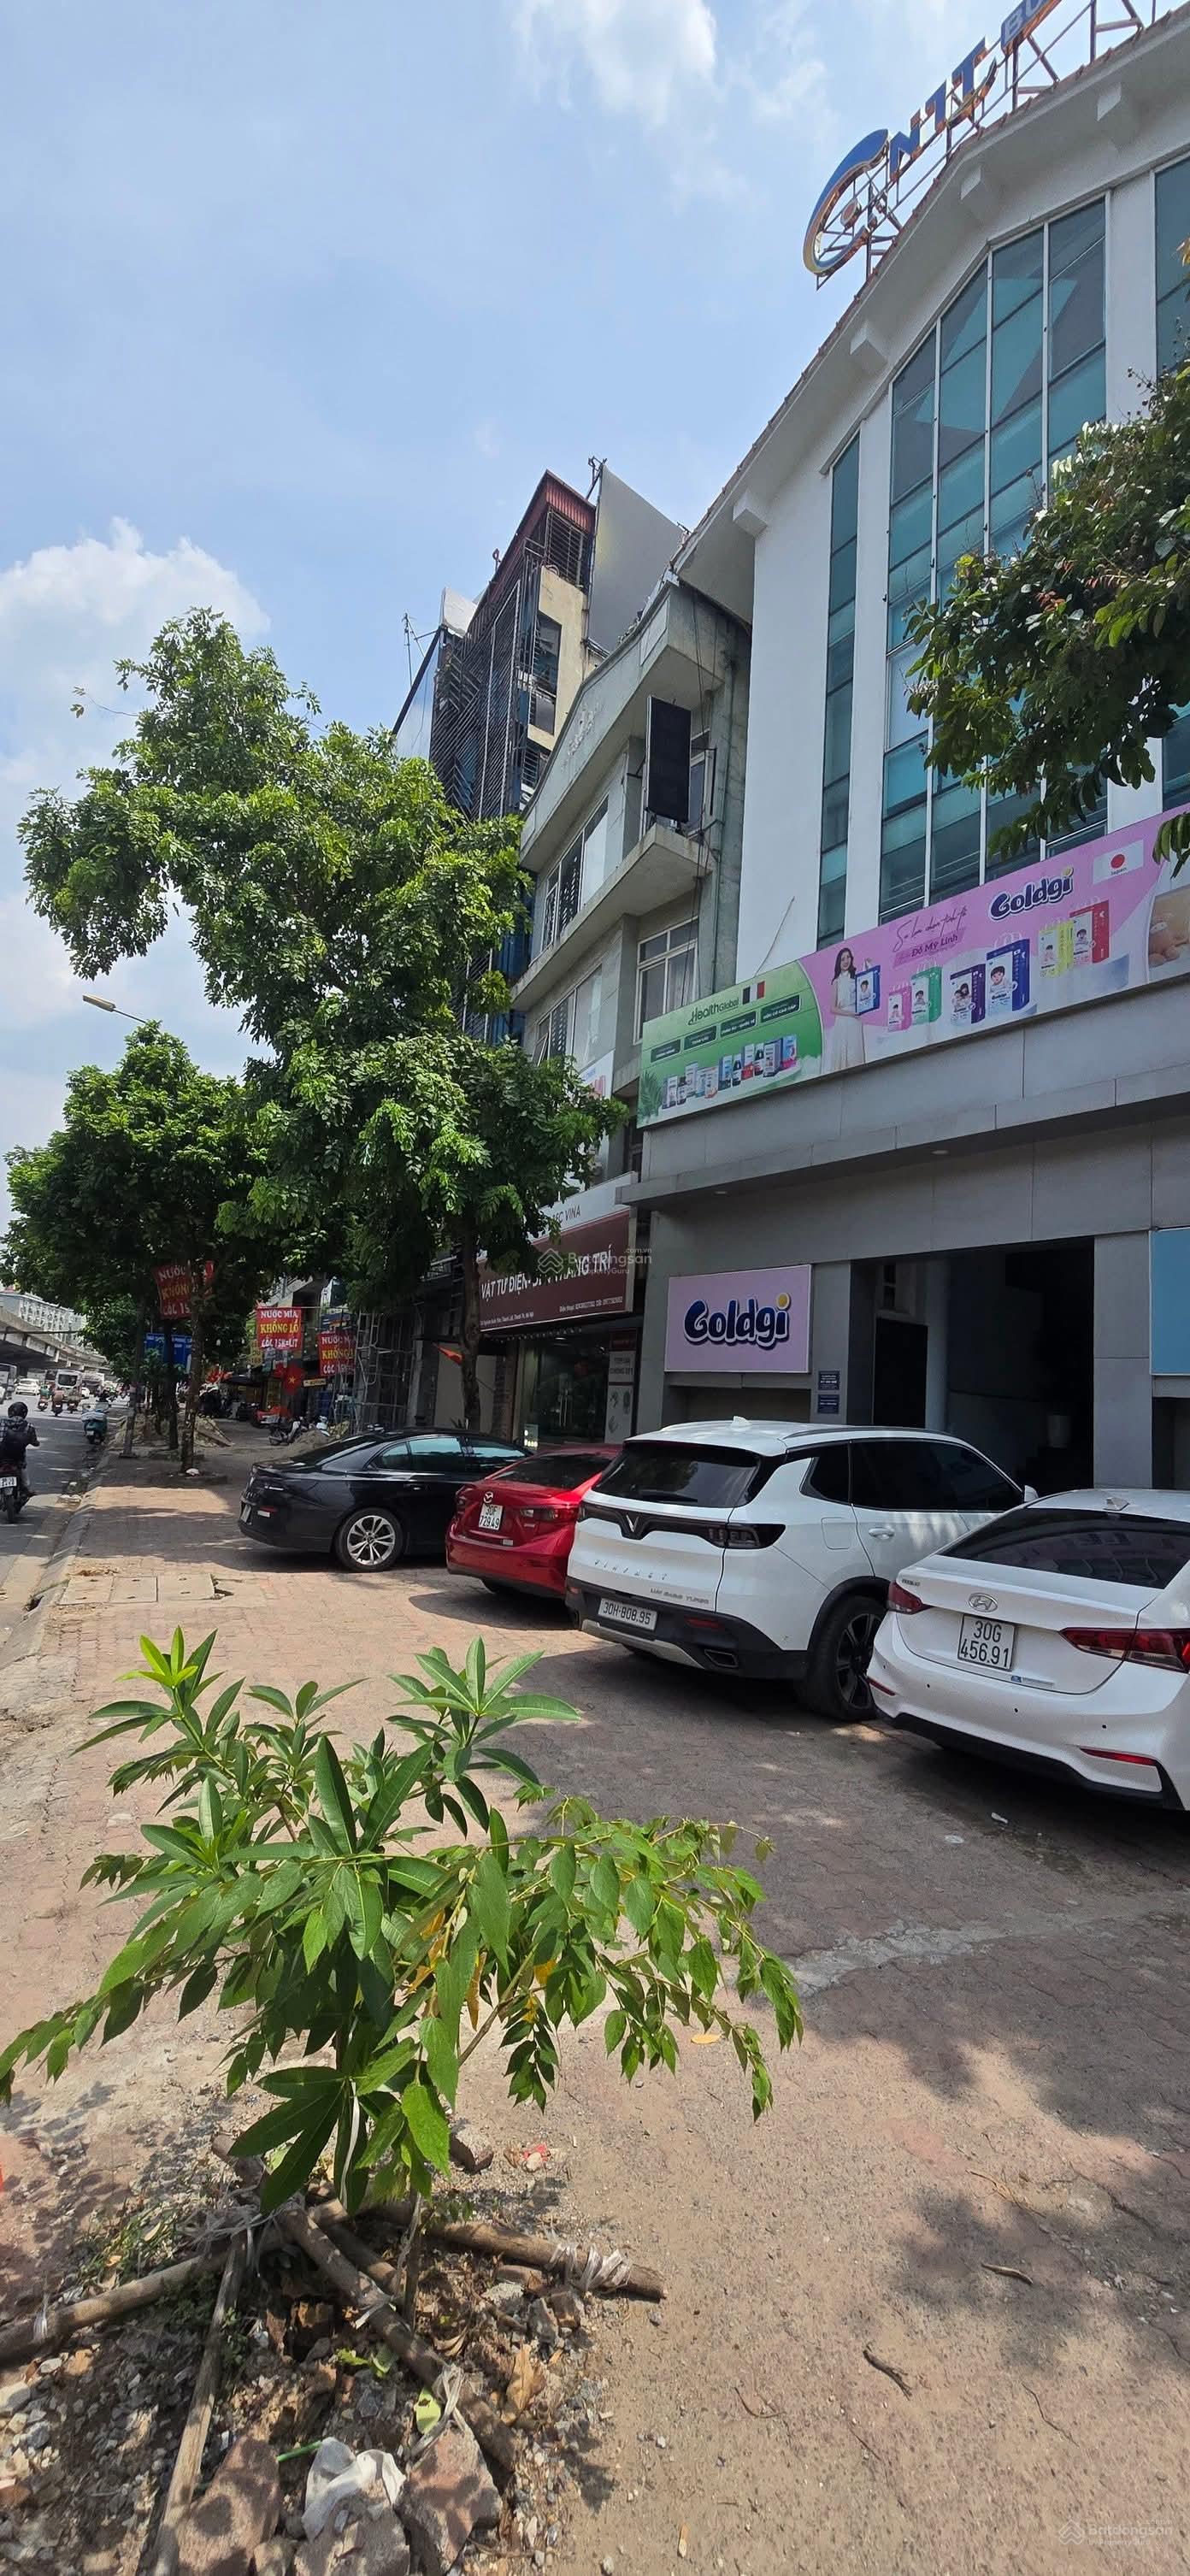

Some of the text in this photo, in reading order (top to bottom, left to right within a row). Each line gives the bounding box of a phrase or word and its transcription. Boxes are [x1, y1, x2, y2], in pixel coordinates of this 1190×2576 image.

[989, 867, 1074, 922] Goldgi
[940, 934, 958, 946] Linh
[565, 1204, 581, 1221] VINA
[592, 1244, 611, 1274] TRÍ
[685, 1292, 791, 1350] Goldgi
[973, 1619, 1002, 1643] 30G
[960, 1636, 1010, 1668] 456.91
